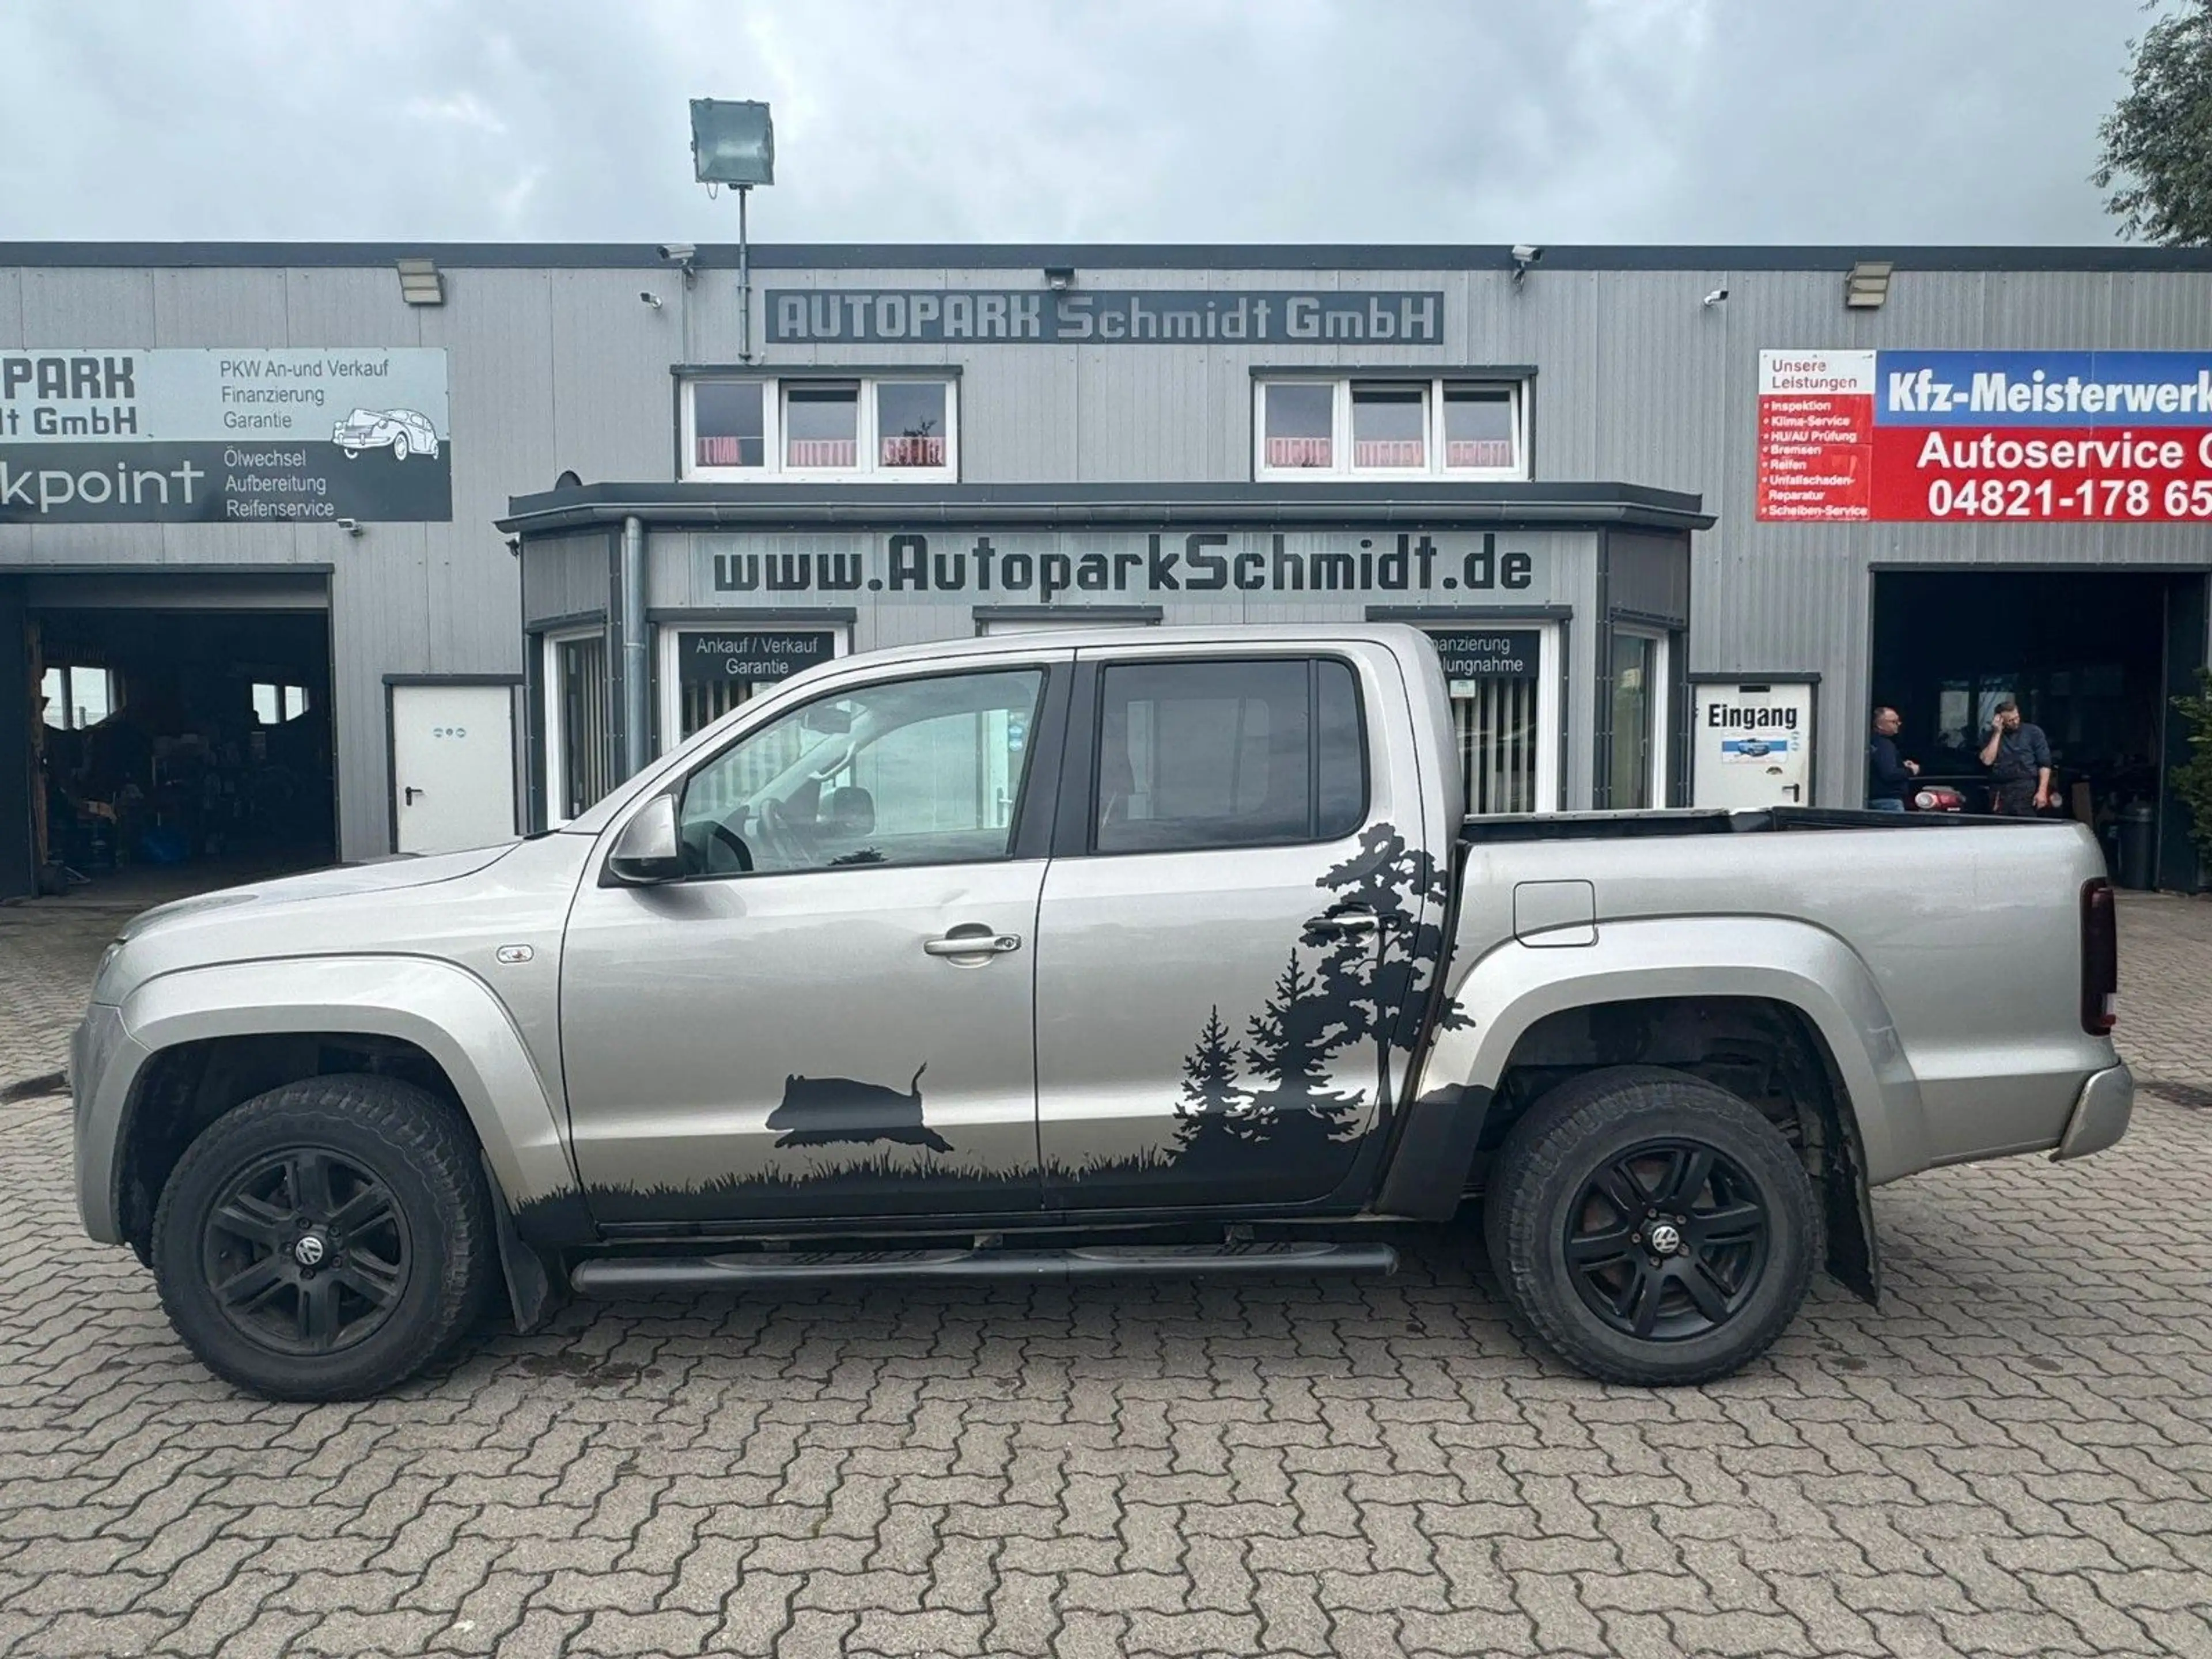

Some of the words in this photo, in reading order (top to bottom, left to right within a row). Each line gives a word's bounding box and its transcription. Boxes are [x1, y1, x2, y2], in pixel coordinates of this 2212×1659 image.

[778, 294, 1040, 339] AUTOPARK
[1057, 295, 1271, 339] Schmidt
[1286, 296, 1434, 339] GmbH
[220, 359, 261, 378] PKW
[264, 359, 322, 377] An-und
[327, 358, 389, 377] Verkauf
[1772, 359, 1827, 372] Unsere
[3, 357, 135, 399] PARK
[1772, 376, 1858, 391] Leistungen
[221, 385, 325, 406] Finanzierung
[1771, 400, 1832, 413] Inspektion
[33, 406, 137, 435] GmbH
[224, 410, 292, 429] Garantie
[1771, 415, 1851, 427] Klima-Service
[1770, 431, 1809, 442] HU/AU
[1810, 430, 1858, 444] Prüfung
[224, 445, 306, 467] Ölwechsel
[1770, 444, 1823, 455] Bremsen
[1916, 431, 2184, 469] Autoservice
[1770, 459, 1807, 470] Reifen
[225, 474, 326, 495] Aufbereitung
[1768, 490, 1826, 502] Reparatur
[1928, 479, 2150, 517] 04821-178
[226, 499, 334, 517] Reifenservice
[1769, 505, 1869, 516] Scheiben-Service
[714, 533, 1531, 603] www.AutoparkSchmidt.de
[696, 637, 748, 654] Ankauf
[760, 637, 819, 653] Verkauf
[726, 657, 789, 675] Garantie
[1709, 704, 1797, 730] Eingang
